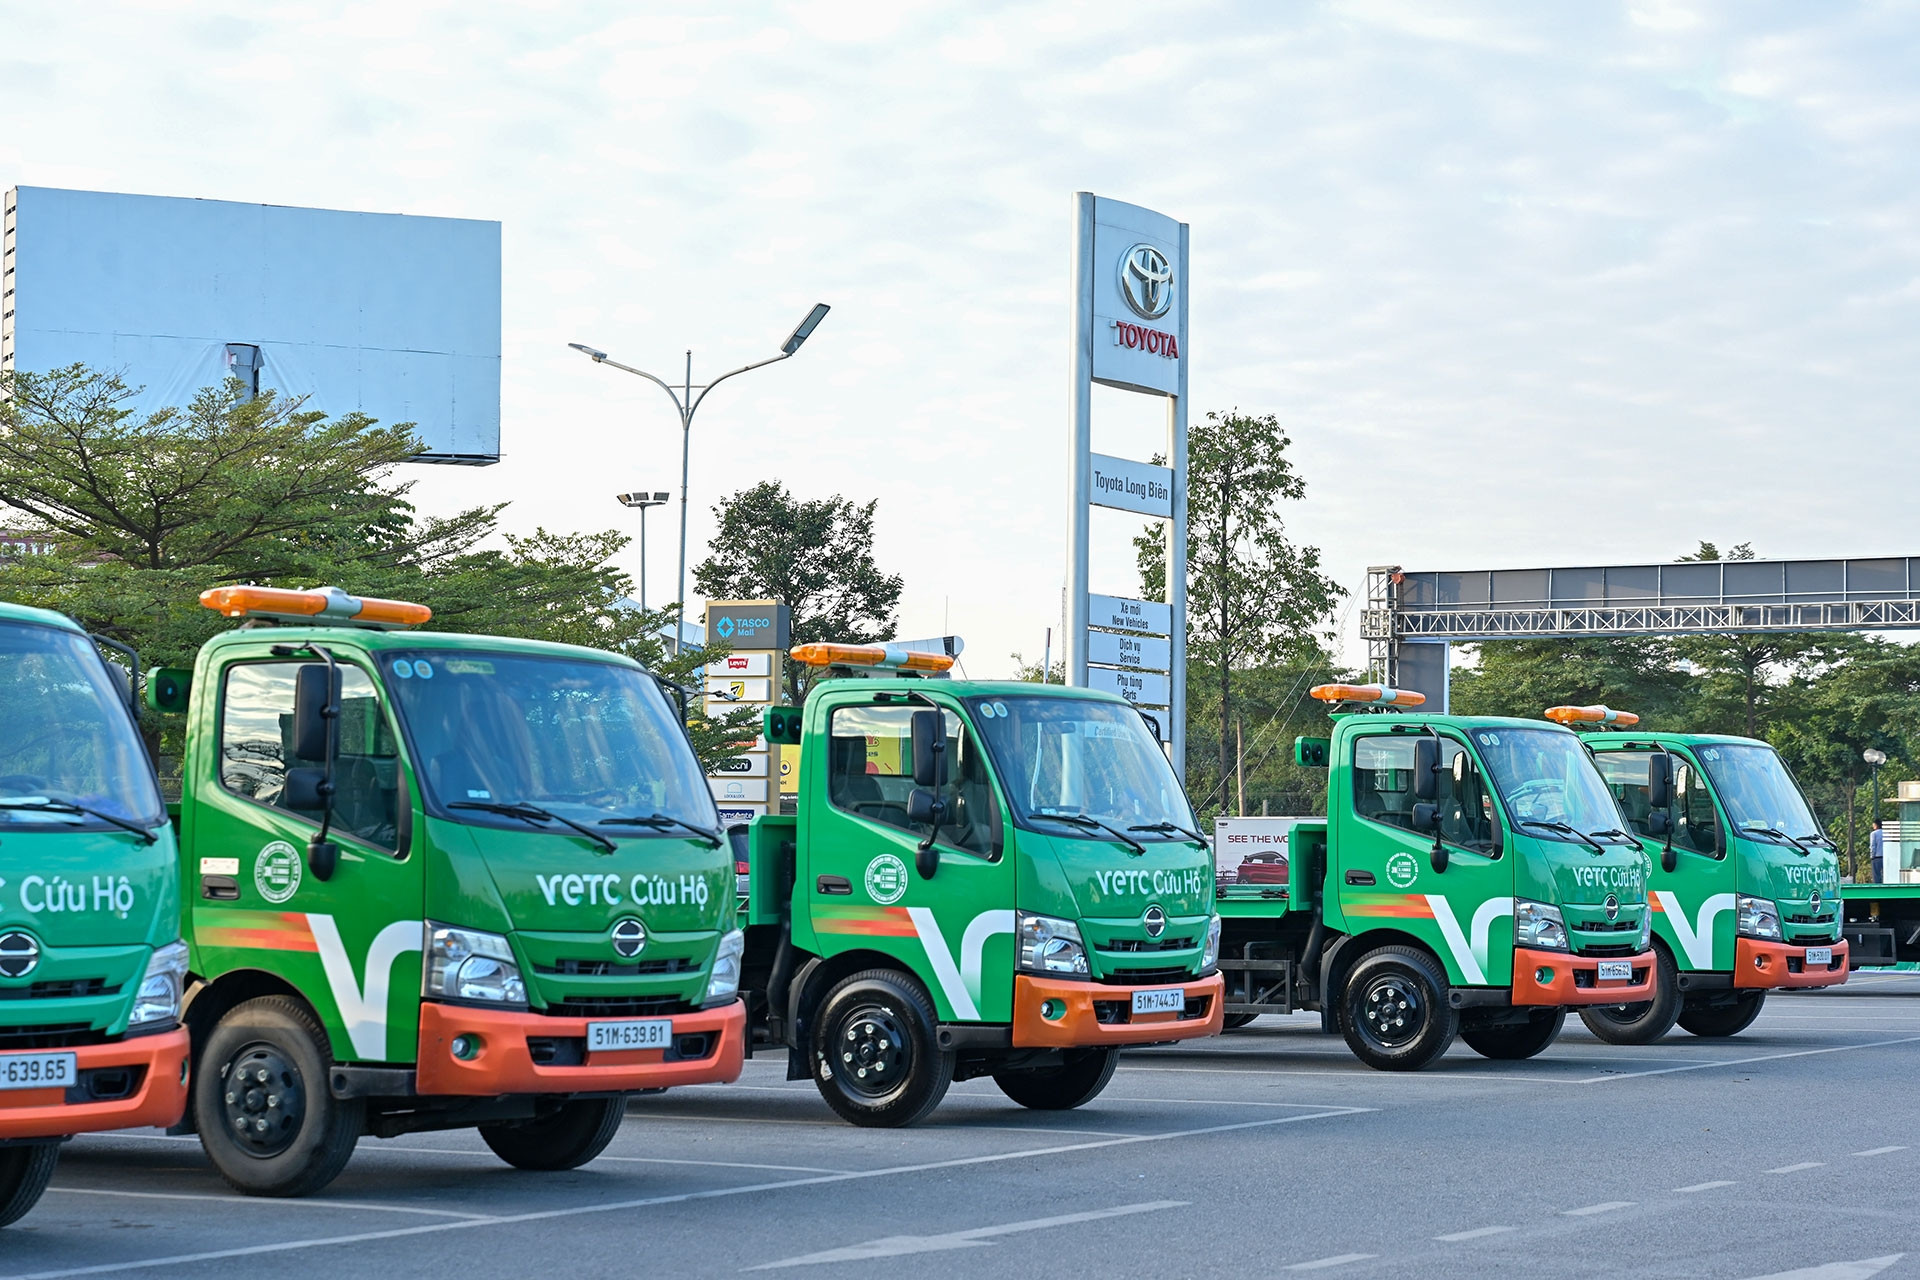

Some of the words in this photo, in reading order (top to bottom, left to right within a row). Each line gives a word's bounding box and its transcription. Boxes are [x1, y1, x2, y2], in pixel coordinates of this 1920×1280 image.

[1116, 320, 1179, 359] TOYOTA
[1094, 470, 1123, 493] Toyota
[1126, 476, 1146, 500] Long
[1149, 481, 1168, 501] Biên
[1120, 602, 1129, 614] Xe
[1130, 603, 1142, 616] mới
[736, 617, 770, 628] TASCO
[1112, 615, 1125, 626] New
[1125, 616, 1149, 630] Vehicles
[737, 628, 755, 636] Mall
[1119, 638, 1133, 652] Dịch
[1134, 642, 1142, 655] vụ
[1119, 652, 1141, 665] Service
[1117, 674, 1129, 689] Phụ
[1130, 675, 1143, 691] tùng
[1122, 688, 1137, 700] Parts
[1227, 835, 1248, 843] SEE
[1250, 835, 1271, 843] THE
[630, 873, 676, 906] Cứu
[680, 874, 709, 911] Hộ
[1153, 869, 1182, 895] Cứu
[1183, 870, 1200, 899] Hộ
[20, 875, 86, 913] Cứu
[92, 875, 135, 919] Hộ
[1137, 993, 1180, 1009] 51M-744.37
[595, 1025, 664, 1045] 51M-639.81
[0, 1060, 66, 1082] -639.65
